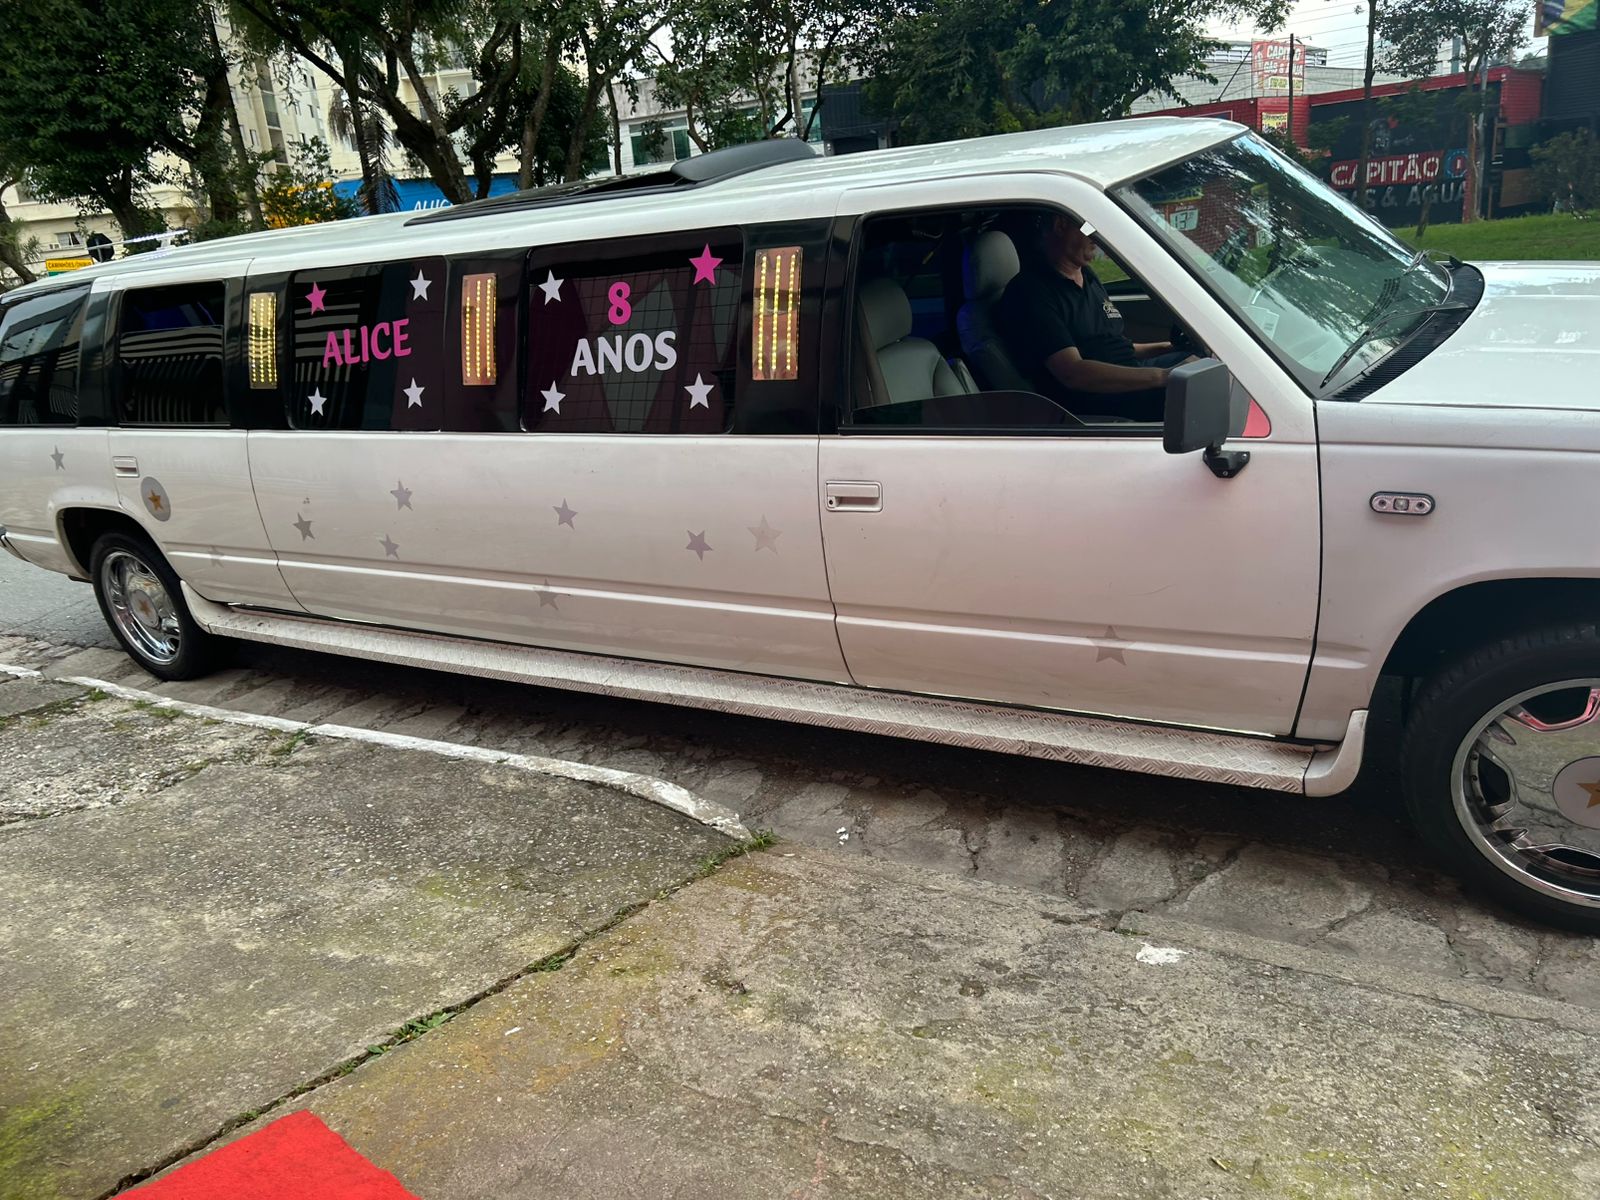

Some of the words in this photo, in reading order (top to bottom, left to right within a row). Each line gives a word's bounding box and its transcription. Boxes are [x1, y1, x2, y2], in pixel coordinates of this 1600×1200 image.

[1383, 185, 1398, 207] &
[608, 281, 632, 325] 8
[323, 318, 412, 368] ALICE
[570, 330, 677, 377] ANOS
